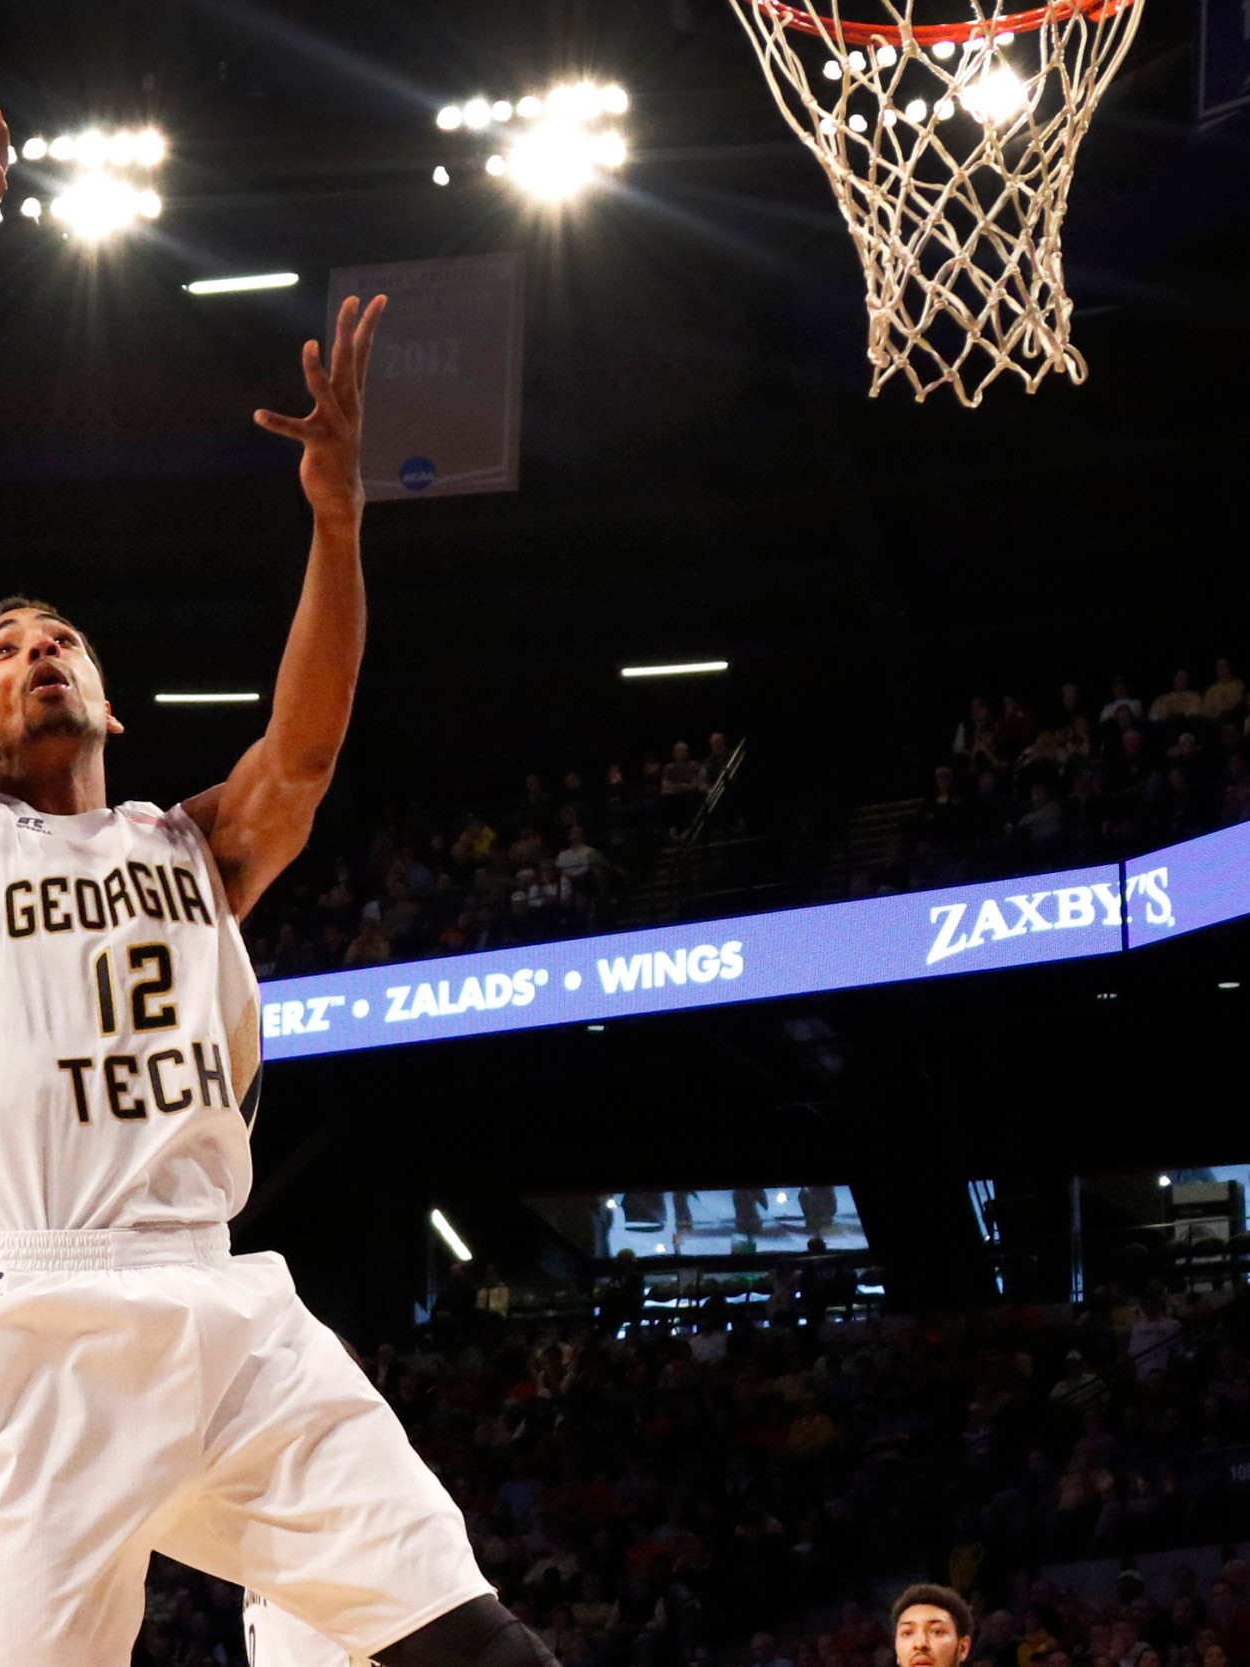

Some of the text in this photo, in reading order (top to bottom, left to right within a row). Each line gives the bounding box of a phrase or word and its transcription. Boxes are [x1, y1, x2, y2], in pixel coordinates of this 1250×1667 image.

[384, 338, 460, 378] 2012
[5, 860, 215, 940] GEORGIA
[926, 867, 1173, 965] ZAXBY'S
[93, 941, 179, 1037] 12
[597, 940, 744, 994] WINGS
[57, 1041, 231, 1126] TECH
